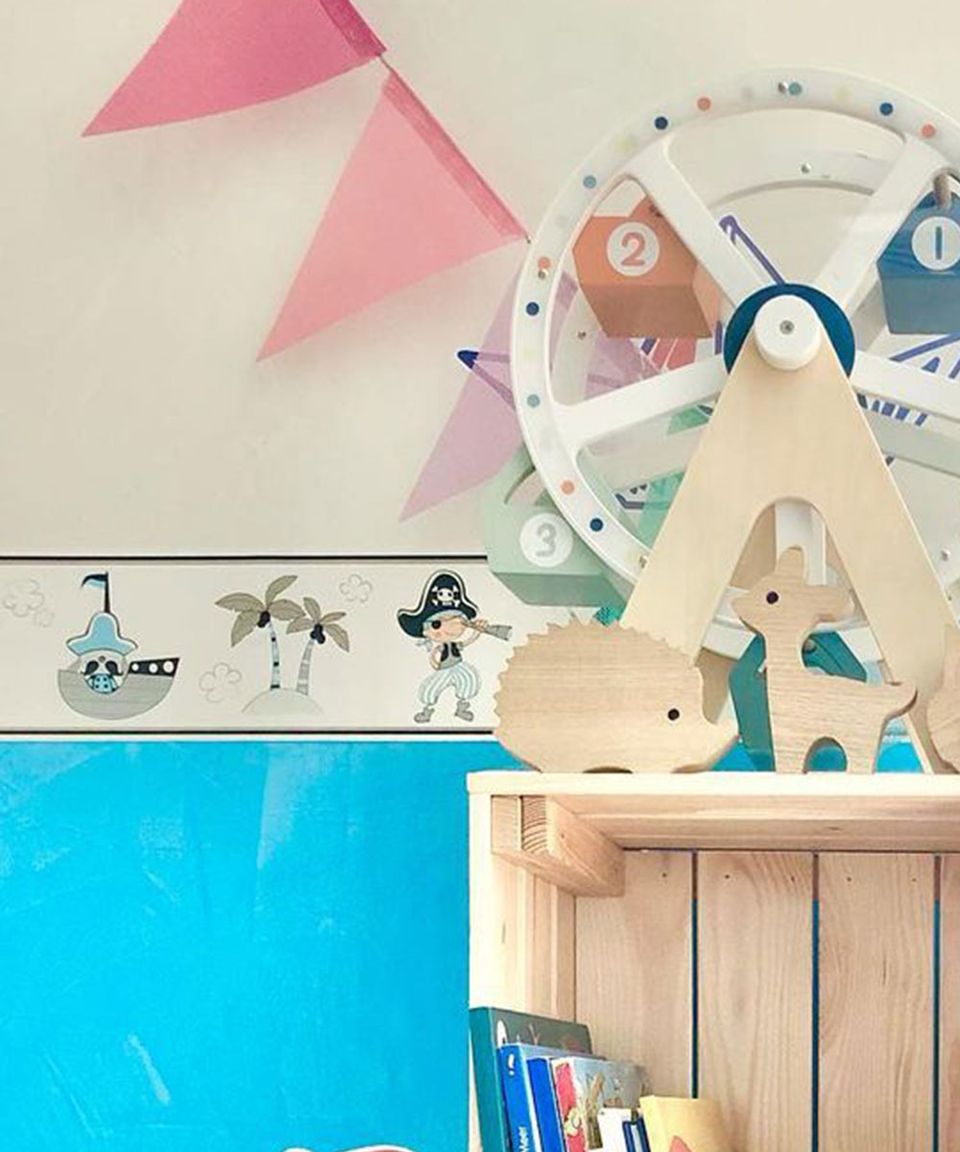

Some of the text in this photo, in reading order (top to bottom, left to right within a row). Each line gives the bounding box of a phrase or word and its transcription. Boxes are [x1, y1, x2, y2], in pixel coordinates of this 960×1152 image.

[619, 231, 647, 267] 2
[935, 226, 943, 261] 1
[534, 522, 558, 557] 3
